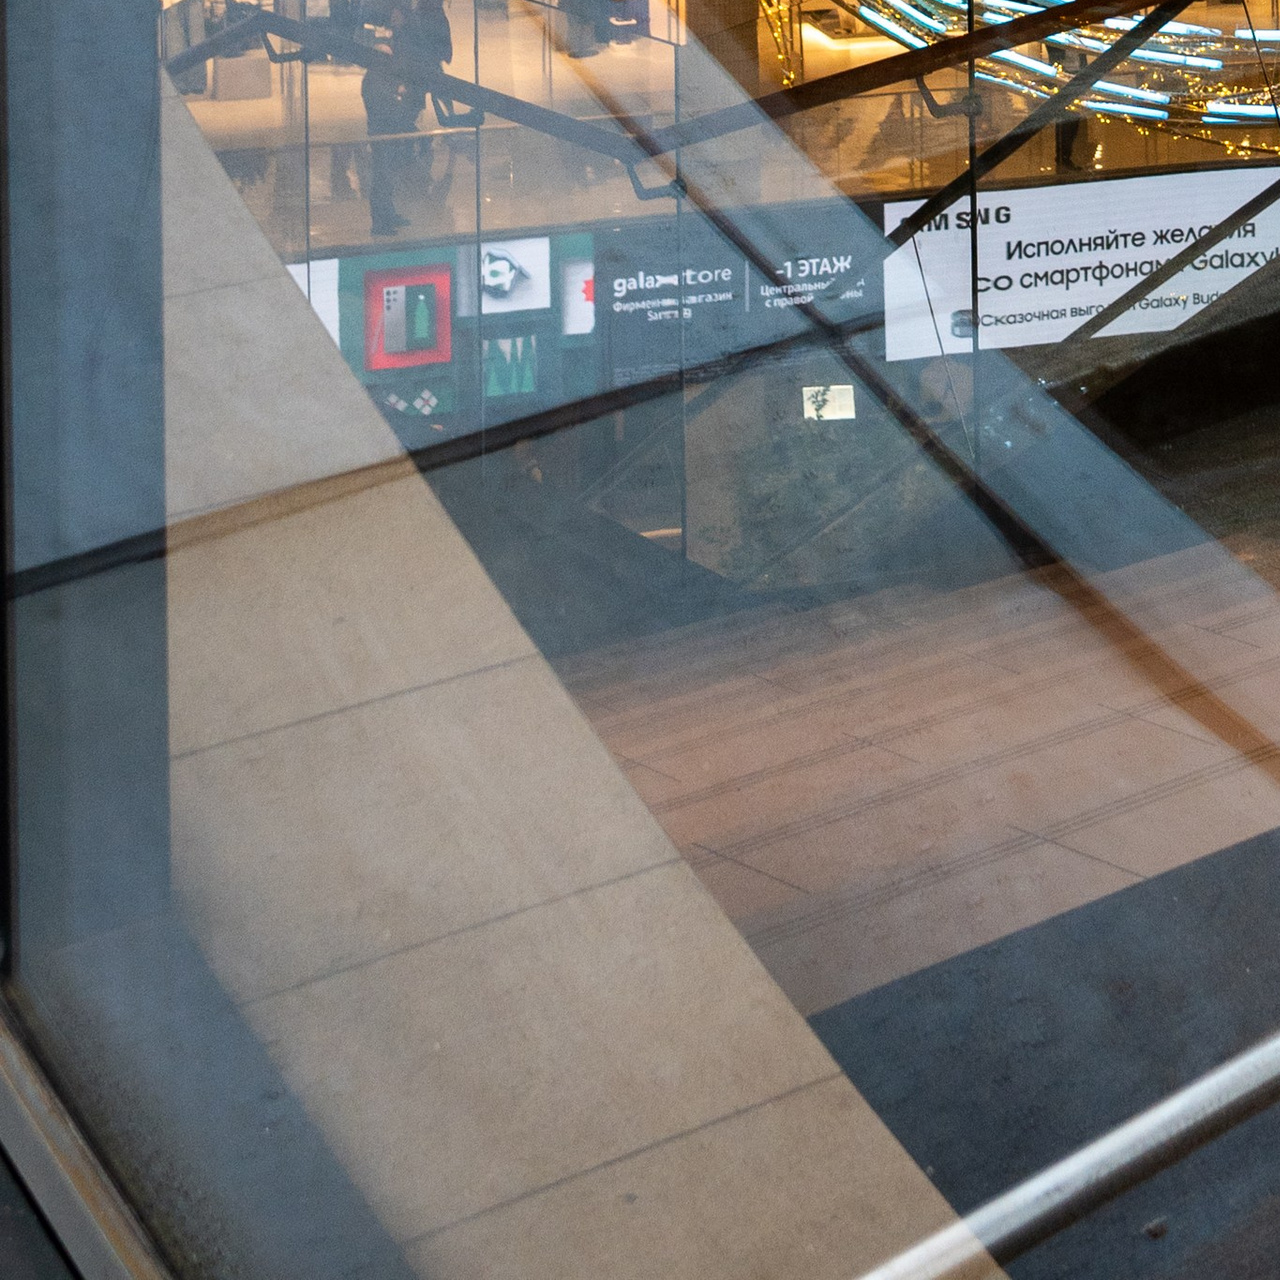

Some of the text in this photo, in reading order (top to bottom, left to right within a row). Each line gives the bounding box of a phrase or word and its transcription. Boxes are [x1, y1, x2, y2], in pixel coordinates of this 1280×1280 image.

[900, 205, 1011, 233] MSNG
[1006, 222, 1256, 260] Исполняйте желия
[776, 255, 853, 279] -1 ЭТАЖ
[1019, 258, 1184, 291] смартфона
[980, 308, 1068, 327] Сказочная
[1070, 304, 1107, 317] выго
[1138, 295, 1189, 310] Galaxy
